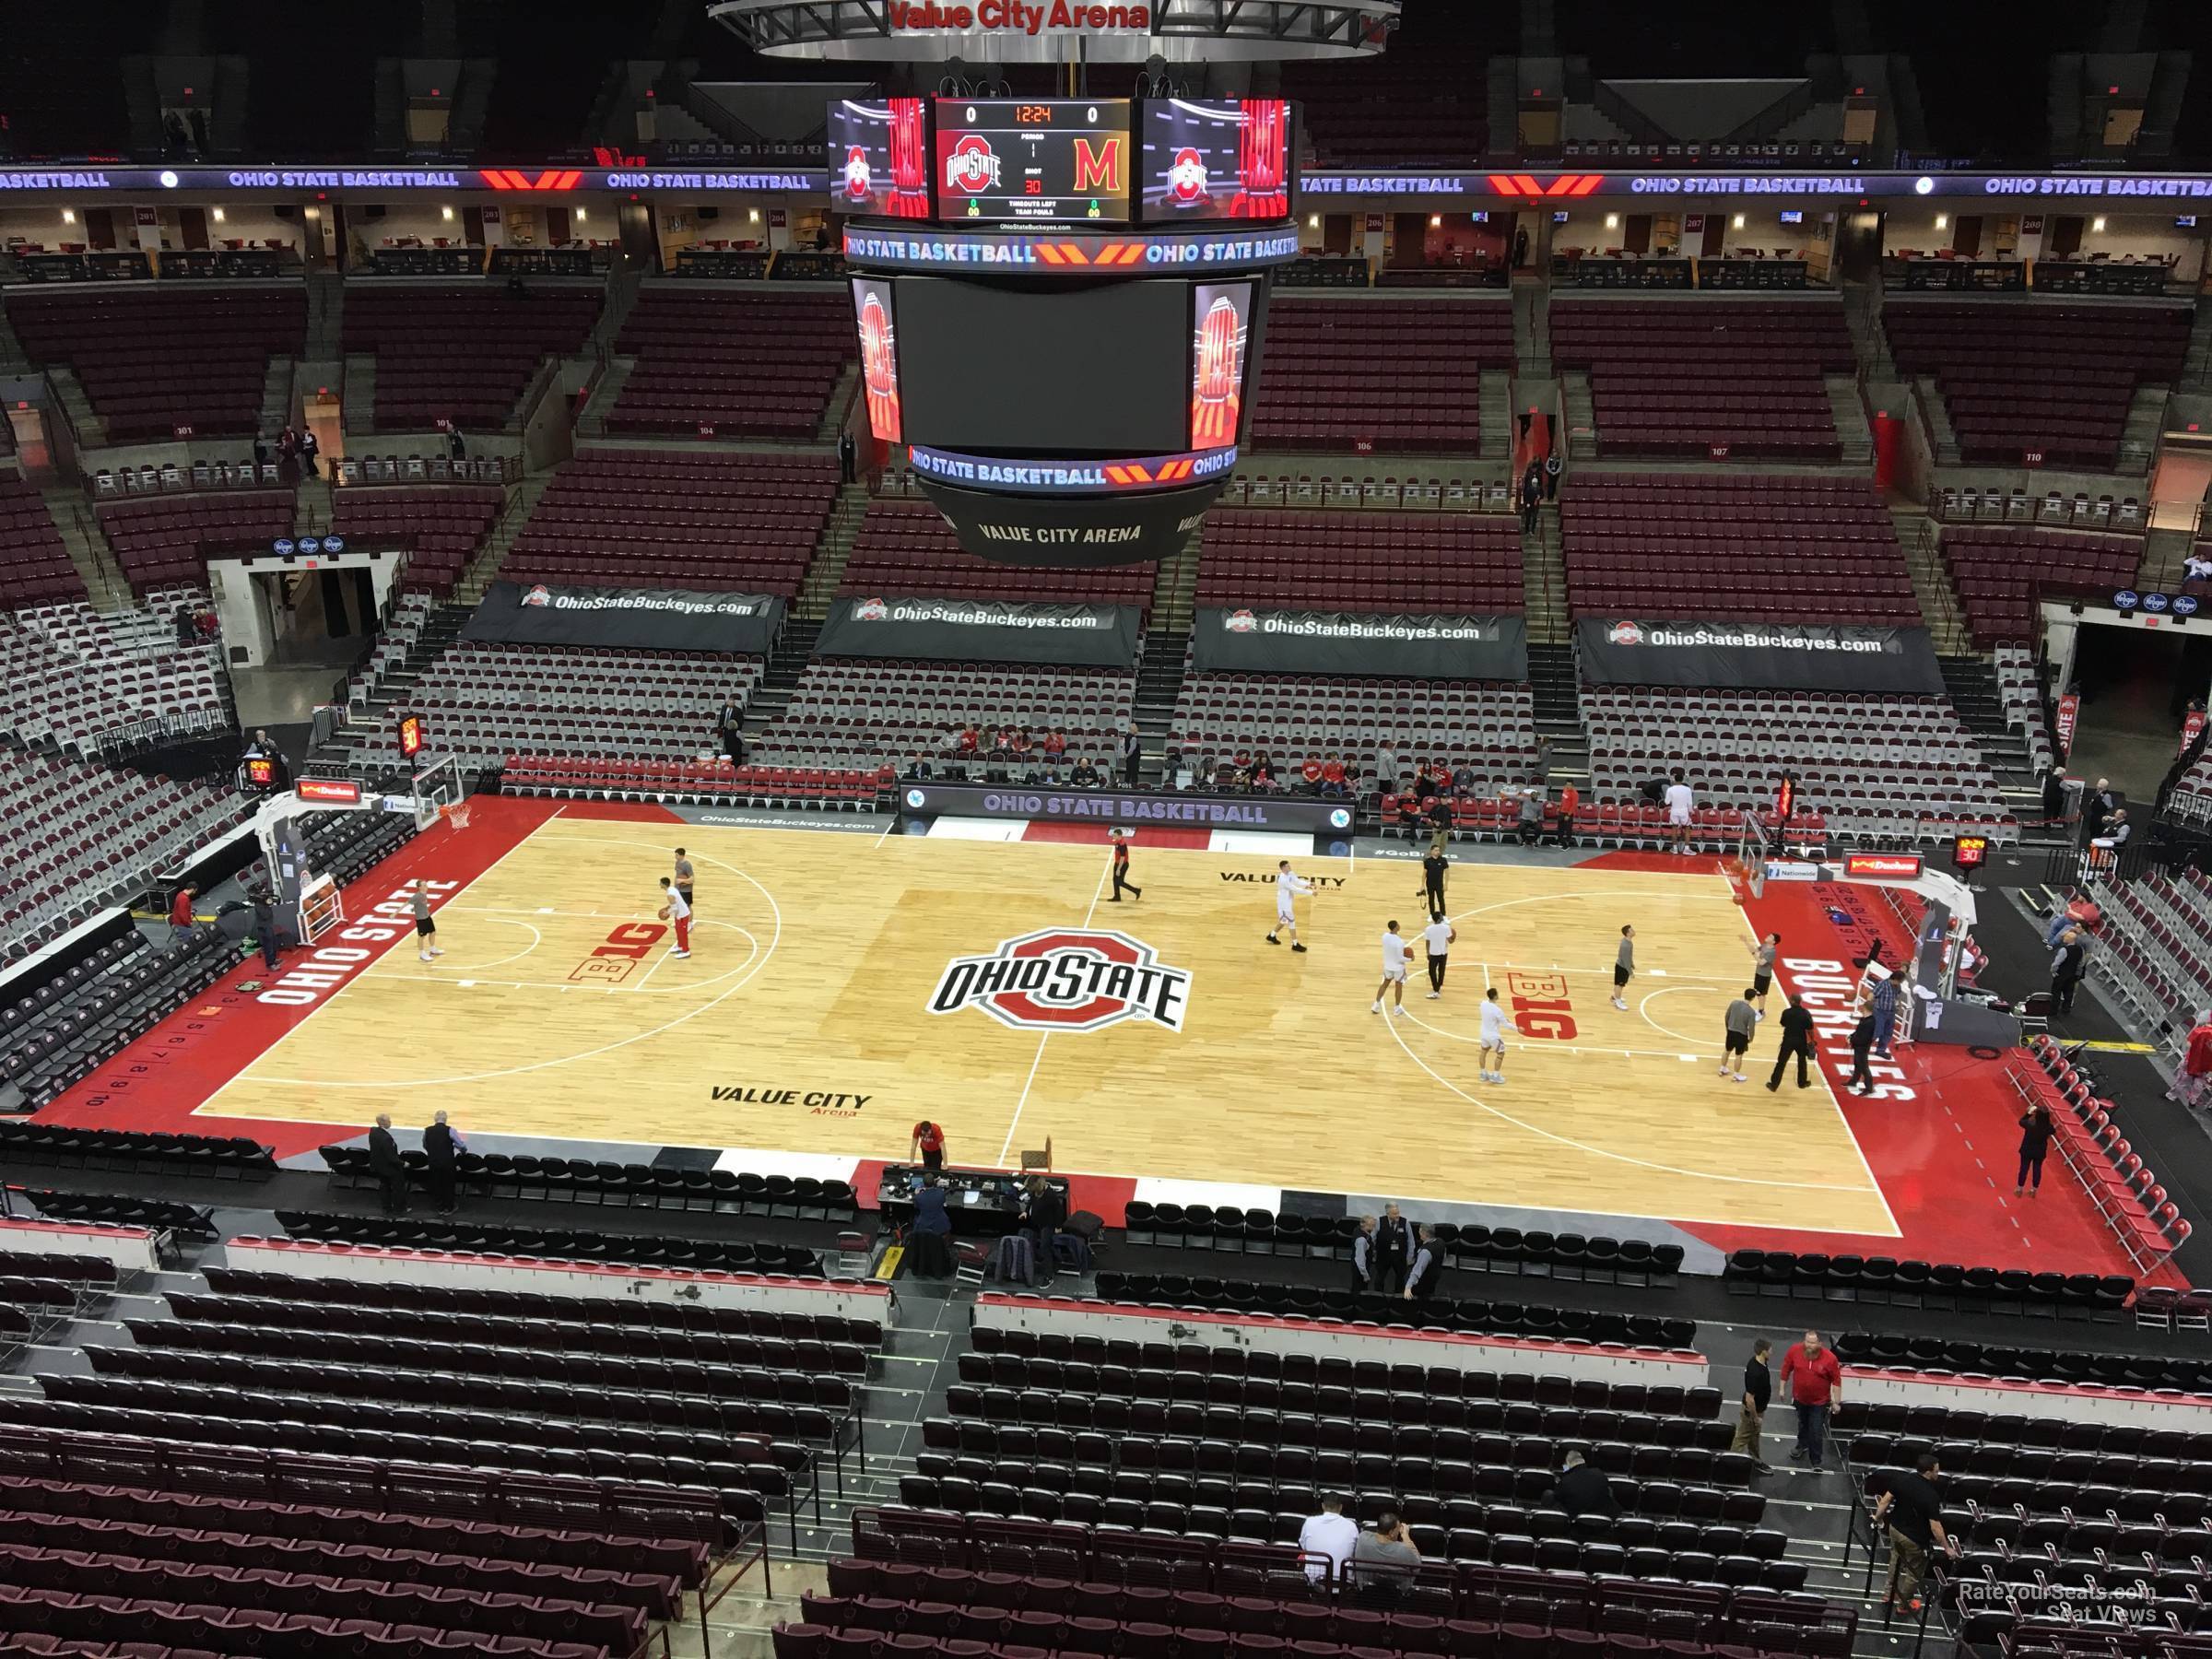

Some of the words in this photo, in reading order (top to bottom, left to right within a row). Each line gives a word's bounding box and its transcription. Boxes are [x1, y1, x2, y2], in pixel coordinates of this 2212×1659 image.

[888, 0, 973, 29] Value
[978, 0, 1044, 35] City
[1047, 0, 1149, 29] Arena
[966, 106, 977, 123] 0
[1017, 106, 1051, 123] 12:24
[1088, 106, 1099, 124] 0
[1074, 138, 1120, 191] M
[229, 172, 278, 187] OHIO
[282, 172, 339, 187] STATE
[343, 172, 459, 187] BASKETBALL
[607, 173, 649, 189] OHIO
[653, 173, 702, 189] STATE
[705, 174, 810, 190] BASKETBALL
[1025, 179, 1041, 194] 30
[1346, 178, 1464, 193] BASKETBALL
[1631, 178, 1681, 193] OHIO
[1684, 178, 1739, 193] STATE
[1742, 178, 1865, 194] BASKETBALL
[1985, 178, 2036, 194] OHIO
[2041, 179, 2102, 194] STATE
[138, 212, 154, 221] 201
[771, 214, 784, 223] 204
[1368, 218, 1382, 228] 206
[1687, 219, 1702, 229] 207
[1000, 223, 1071, 231] OhioStateBuckeyes.com
[848, 237, 865, 255] OHIO
[867, 240, 906, 259] STATE
[910, 241, 1036, 263] BASKETBALL
[1147, 244, 1199, 263] OHIO
[1203, 241, 1252, 261] STATE
[177, 427, 192, 436] 101
[700, 427, 713, 436] 104
[1357, 441, 1372, 451] 106
[1712, 447, 1728, 456] 107
[1194, 453, 1223, 476] OHIO
[2027, 453, 2042, 462] 110
[912, 448, 931, 472] OHIO
[932, 456, 974, 479] STATE
[978, 464, 1106, 485] BASKETBALL
[979, 523, 1030, 542] VALUE
[1037, 527, 1079, 543] CITY
[1083, 524, 1142, 543] ARENA
[555, 595, 753, 616] OhioStateBuckeyes.com
[2116, 593, 2136, 606] Kroger
[2145, 595, 2165, 609] Kroger
[2174, 598, 2195, 612] Kroger
[894, 606, 1098, 629] OhioStateBuckeyes.com
[1265, 618, 1480, 641] OhioStateBuckeyes.com
[1651, 629, 1882, 653] OhioStateBuckeyes.com
[253, 770, 267, 780] 30
[983, 794, 1042, 813] OHIO
[1047, 797, 1114, 817] STATE
[1121, 800, 1268, 824] BASKETBALL
[700, 815, 876, 830] OhioStateBuckeyes.com
[1960, 839, 1985, 849] 12:24
[1962, 849, 1979, 861] 30
[1220, 872, 1279, 884] VALU
[257, 947, 371, 1006] OHIO
[339, 878, 459, 941] STATE
[711, 1086, 801, 1105] VALUE
[803, 1091, 873, 1110] CITY
[810, 1107, 857, 1118] Arena
